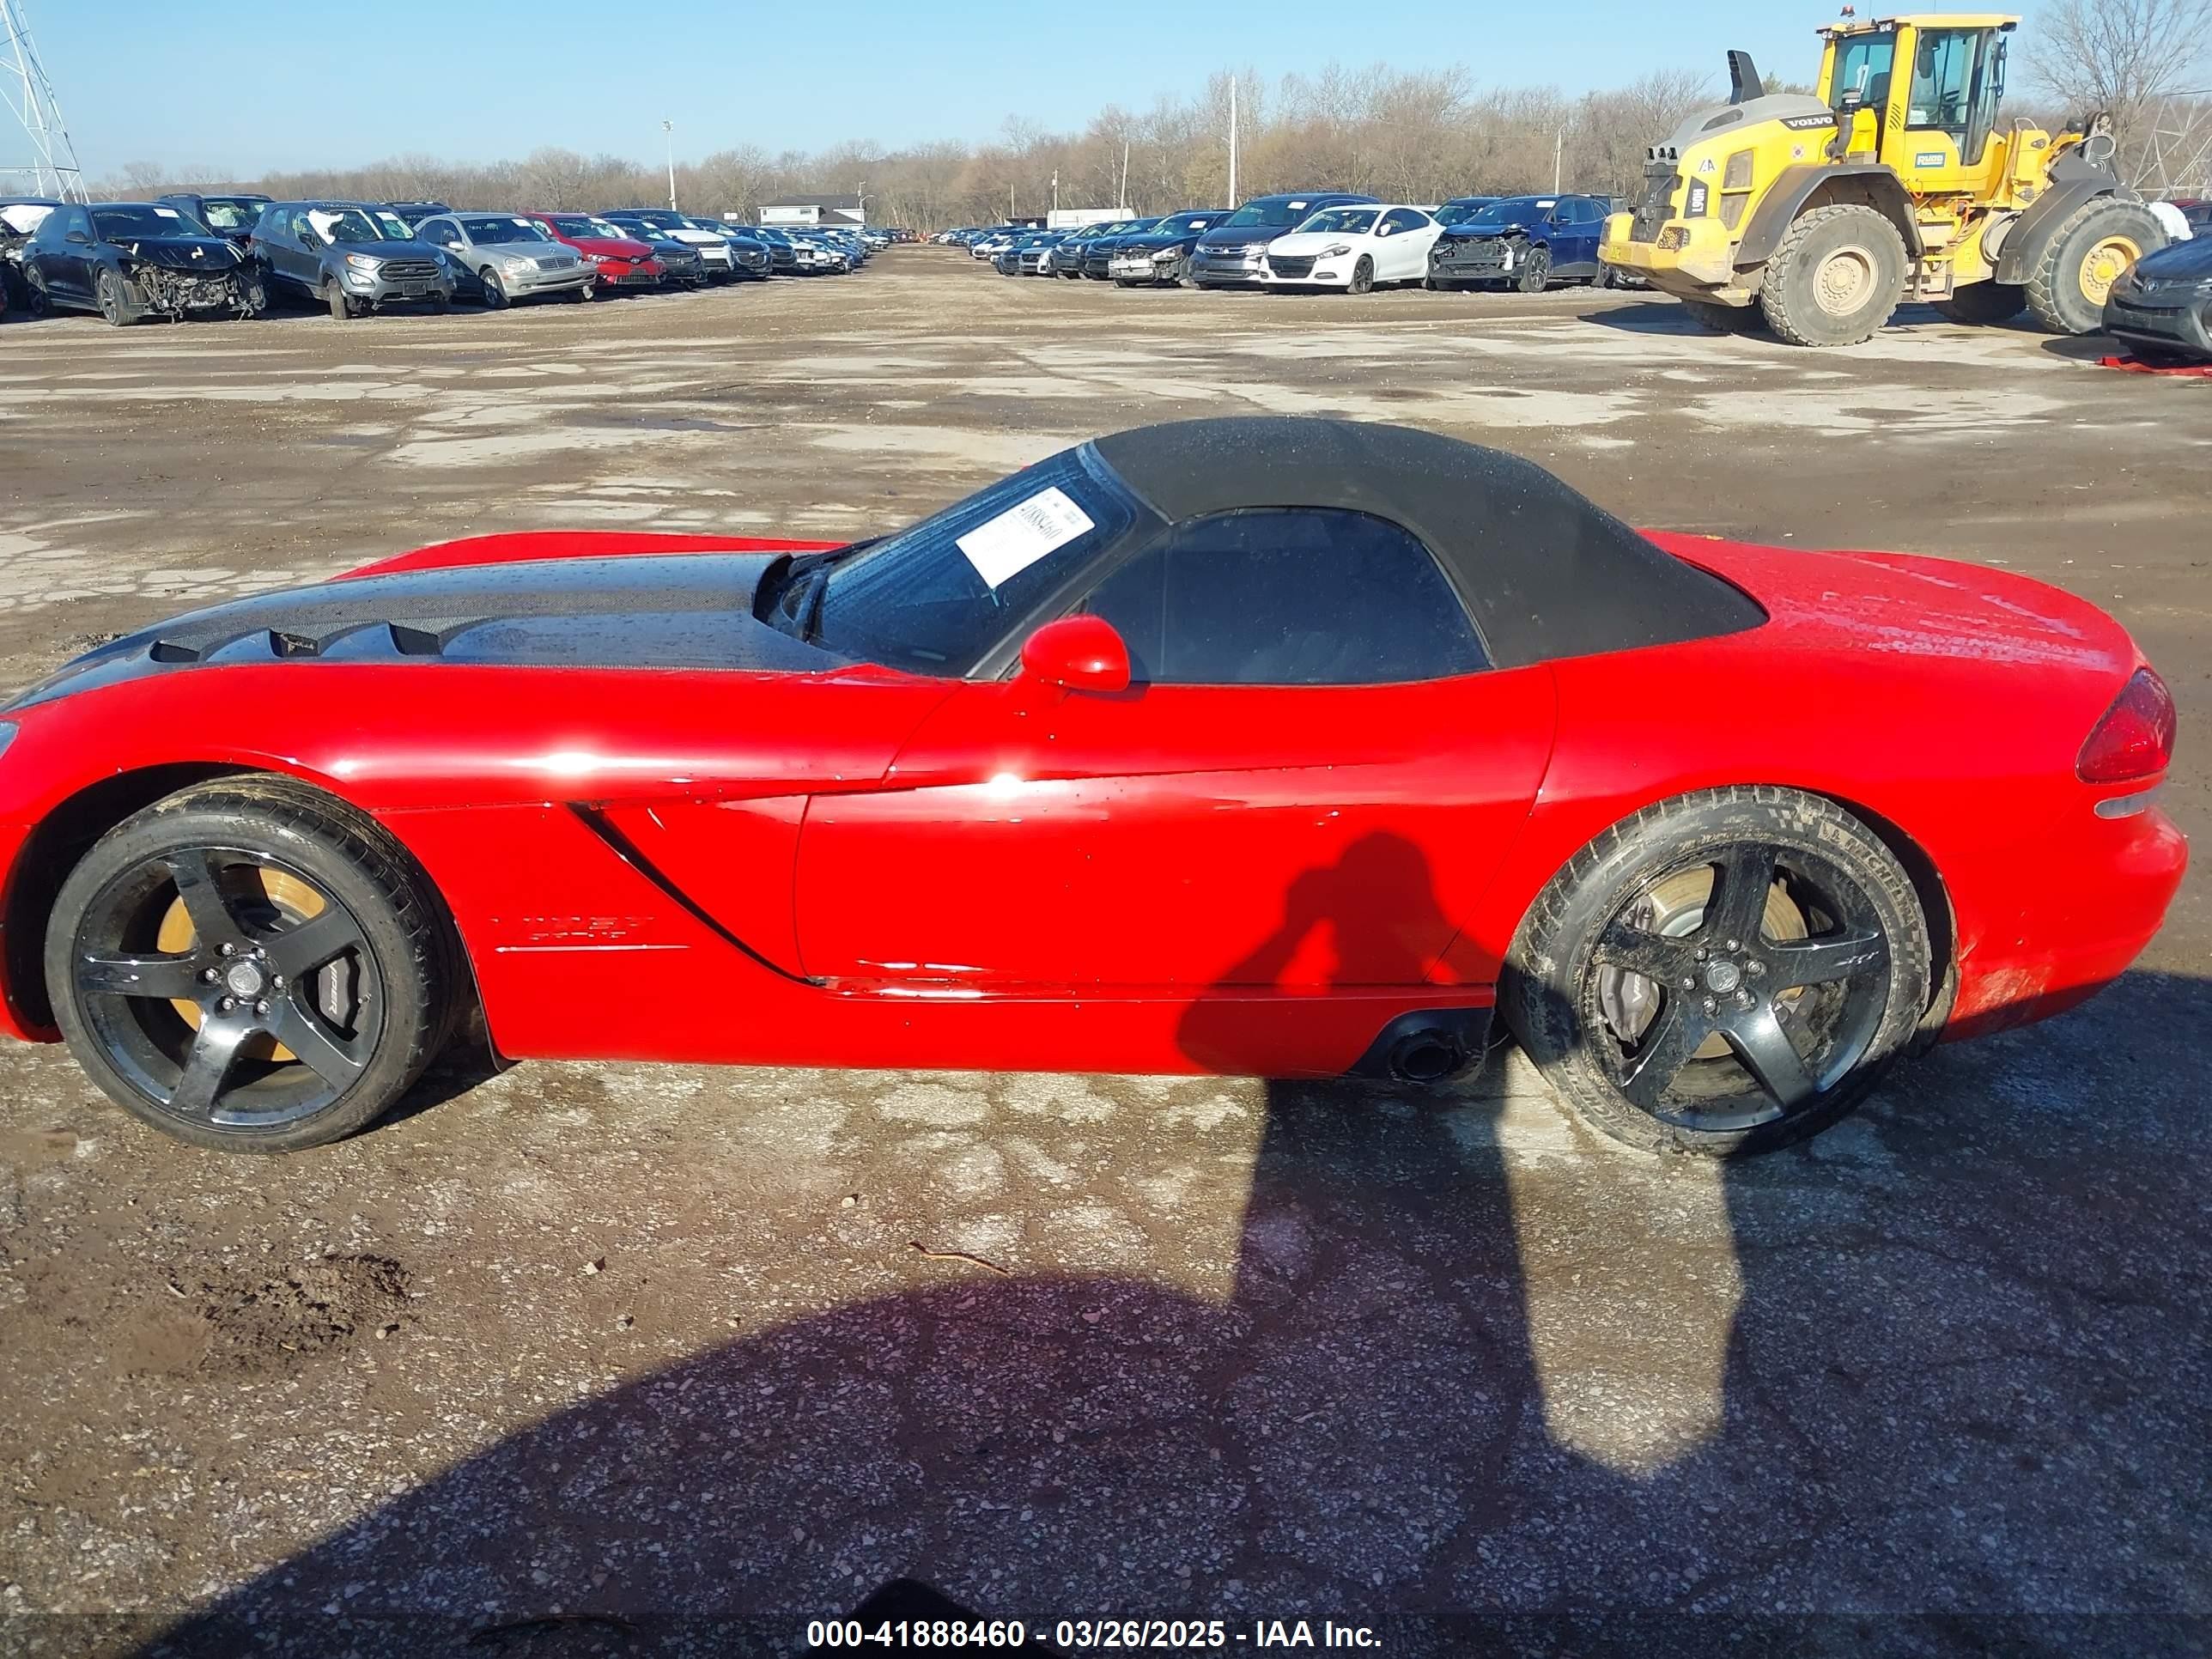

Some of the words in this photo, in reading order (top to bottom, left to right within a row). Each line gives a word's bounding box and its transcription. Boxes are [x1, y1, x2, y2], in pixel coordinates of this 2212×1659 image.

[1787, 117, 1833, 127] VOLVO
[1692, 188, 1705, 213] L90H
[328, 961, 337, 1015] VIPER
[1632, 974, 1643, 1004] VIP
